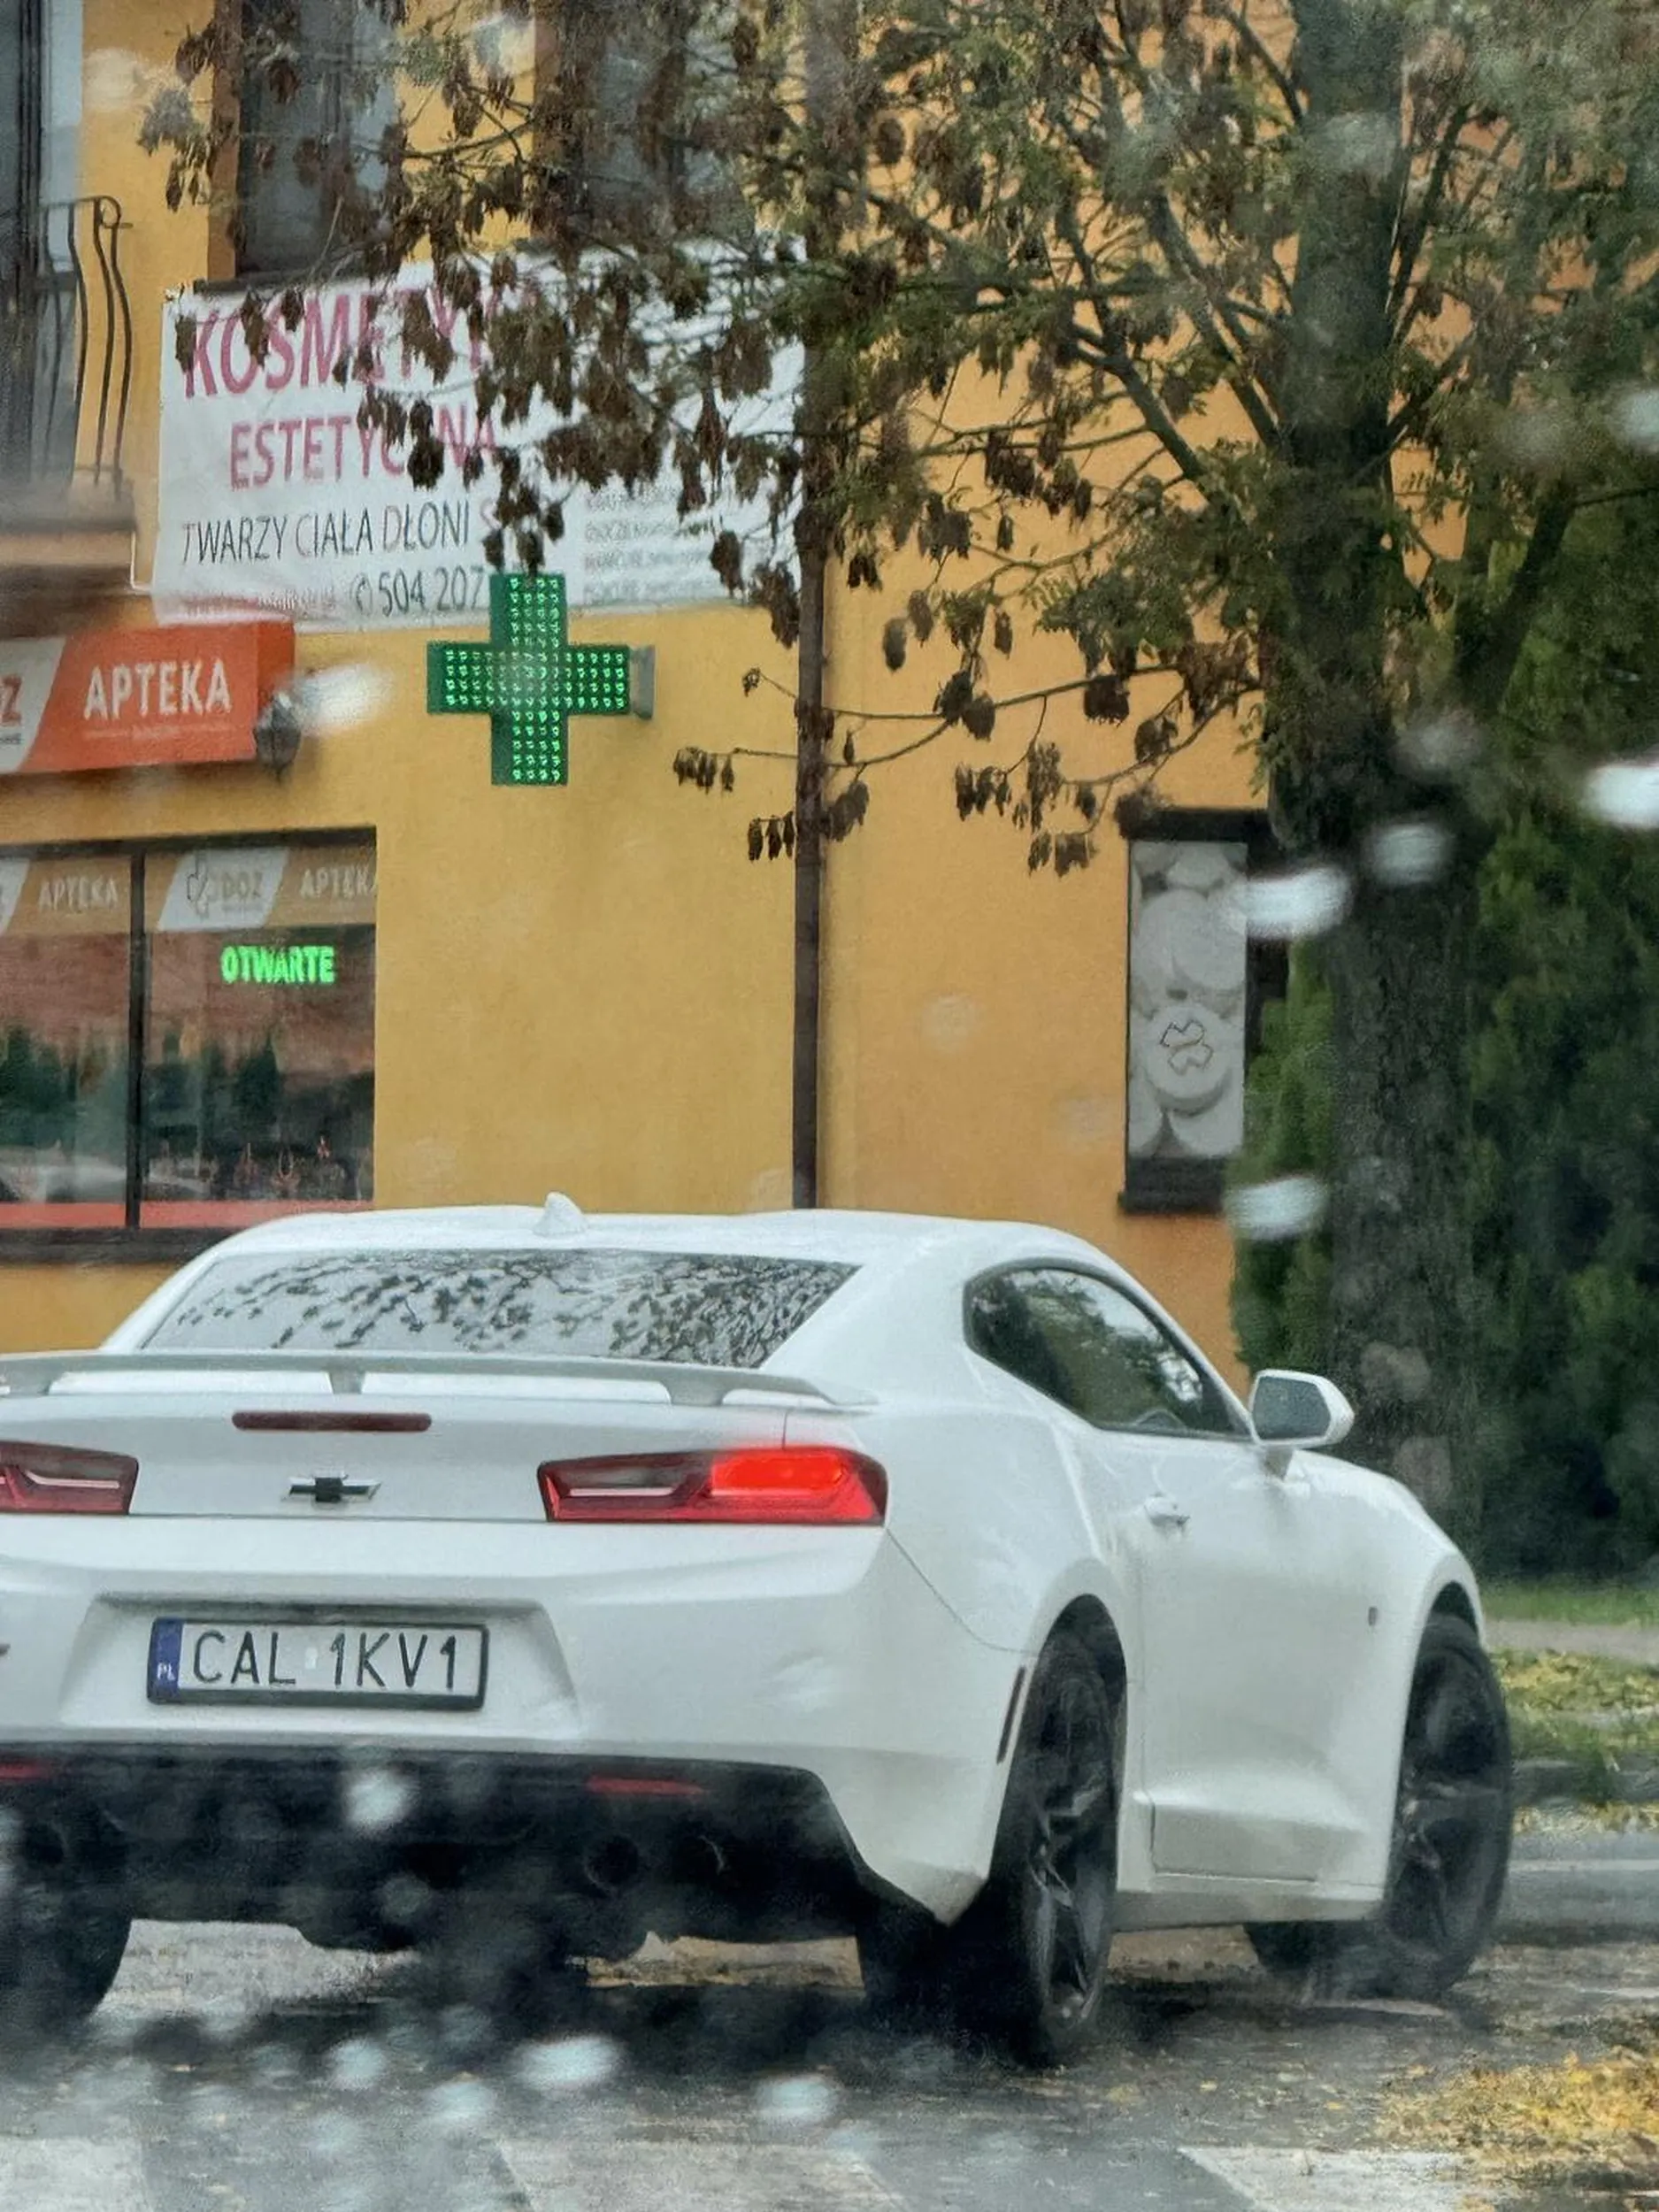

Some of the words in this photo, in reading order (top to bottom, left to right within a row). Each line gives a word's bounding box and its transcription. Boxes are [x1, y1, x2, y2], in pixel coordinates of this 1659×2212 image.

[231, 402, 498, 491] ESTETYCNA
[182, 517, 288, 564] TWARZY
[295, 507, 374, 558] CIAŁA
[383, 500, 469, 550] DŁONI
[379, 566, 427, 617] 504
[434, 564, 486, 611] 207
[83, 657, 232, 720] APTEKA
[222, 945, 335, 983] OTWARTE
[193, 1629, 296, 1685] CAL
[330, 1632, 457, 1689] 1KV1
